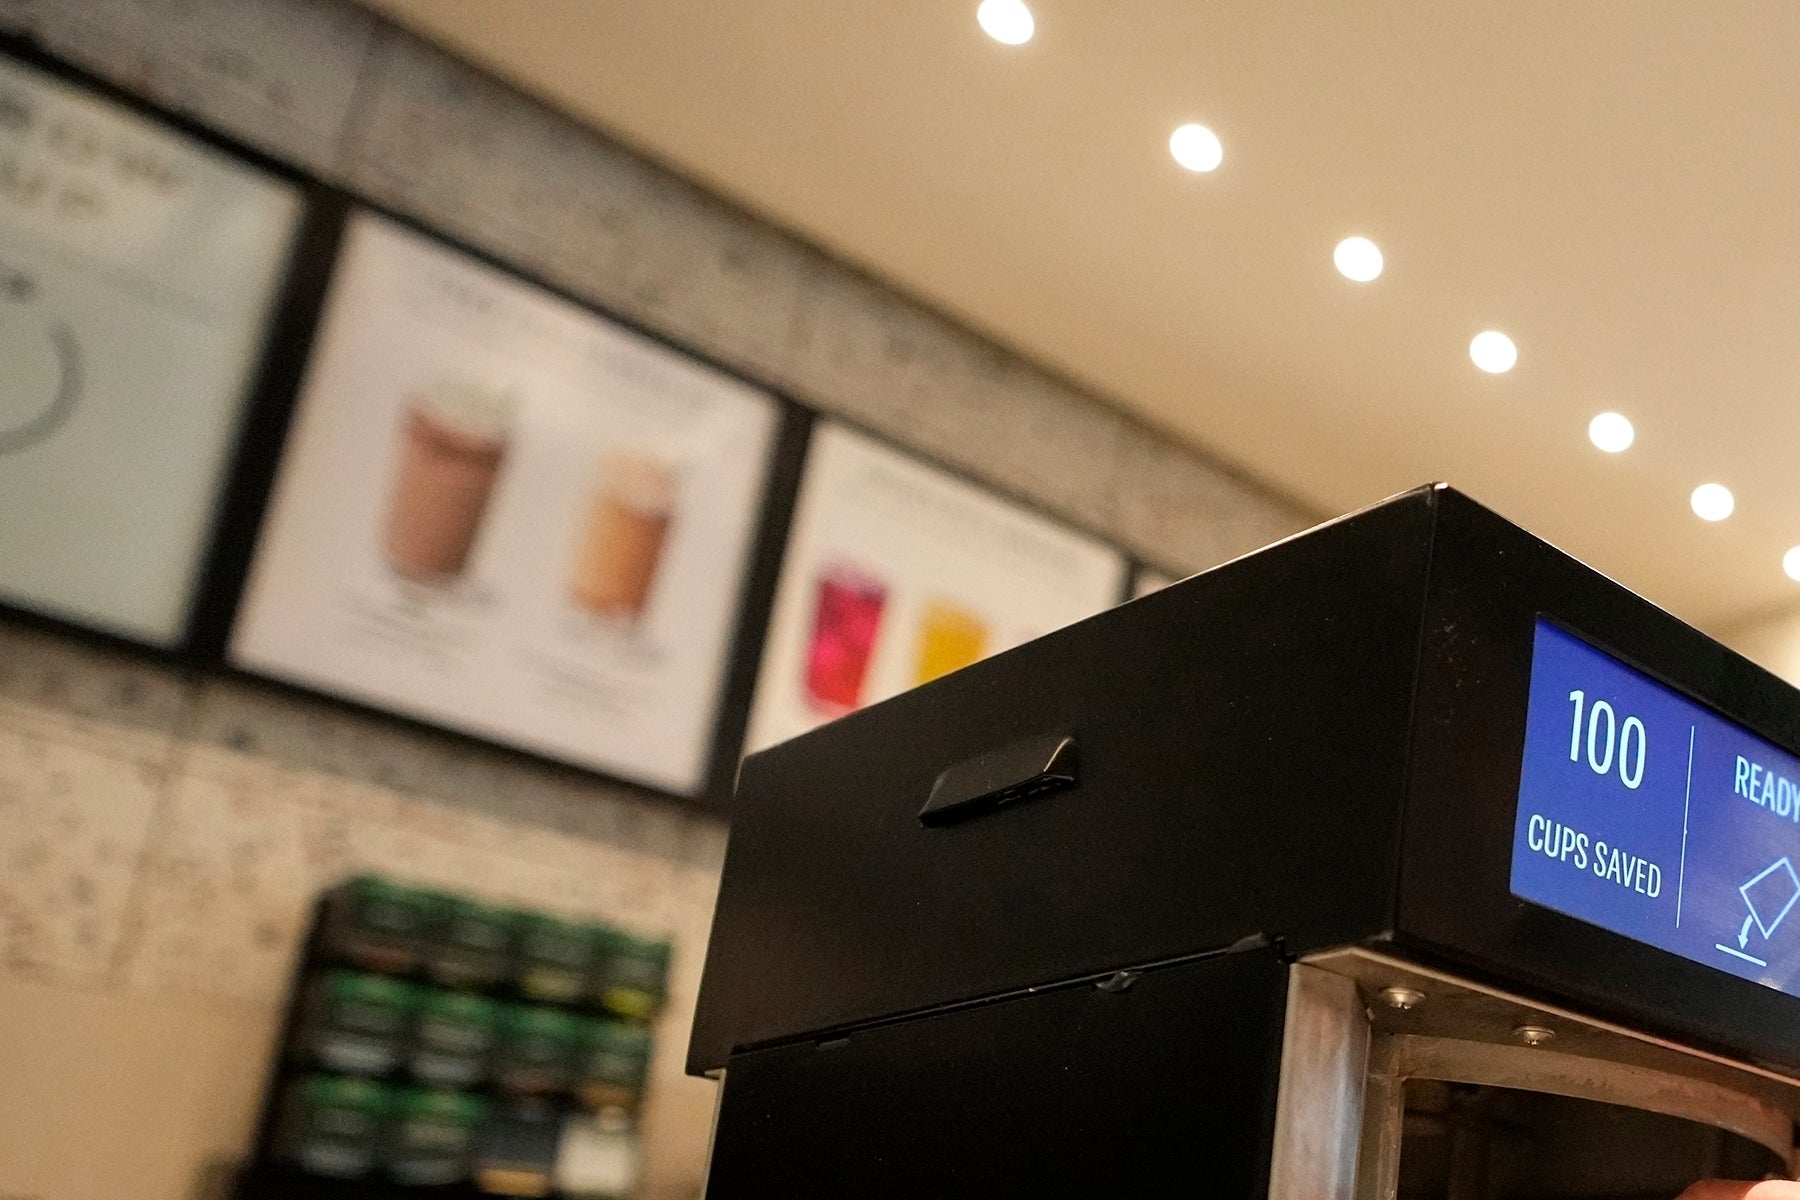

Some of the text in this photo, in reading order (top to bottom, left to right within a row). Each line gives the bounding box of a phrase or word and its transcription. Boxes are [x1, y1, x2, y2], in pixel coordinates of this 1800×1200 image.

[1568, 689, 1646, 789] 100
[1527, 814, 1661, 899] CUPS SAVED
